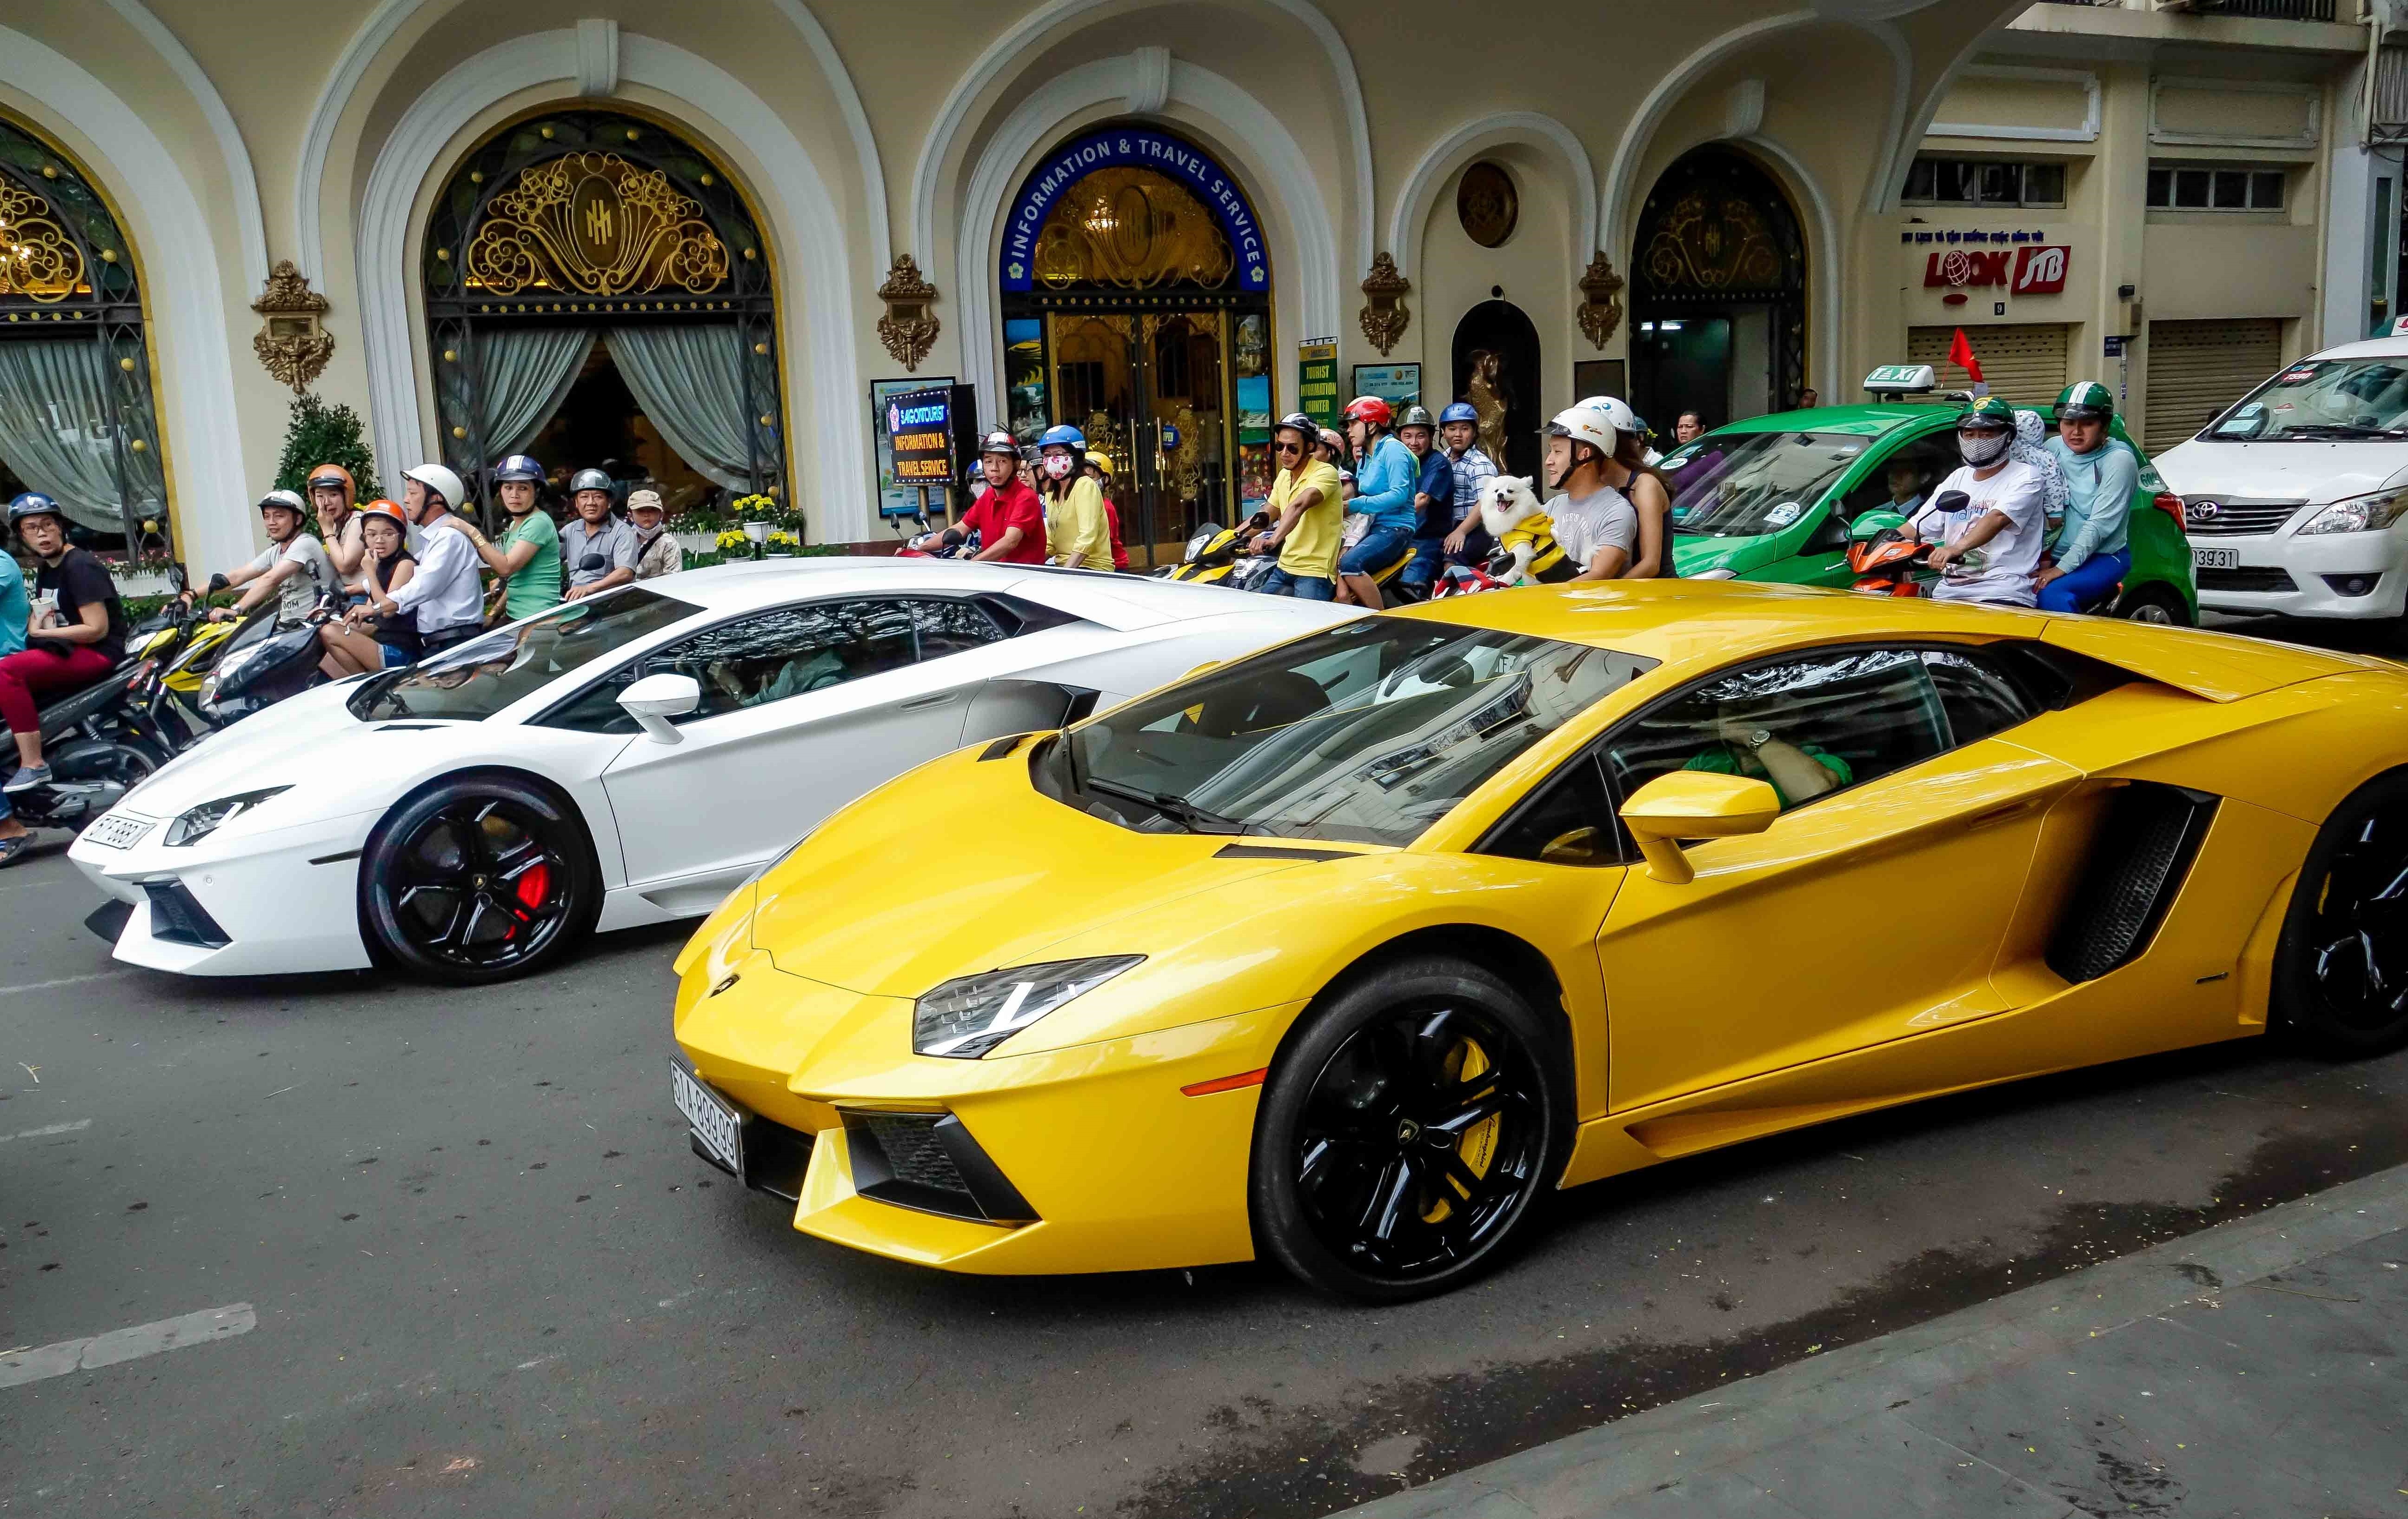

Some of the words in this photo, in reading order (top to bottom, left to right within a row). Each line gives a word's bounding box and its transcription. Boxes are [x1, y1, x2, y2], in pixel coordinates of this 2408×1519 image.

[1011, 141, 1110, 258] INFORMATION
[1119, 139, 1131, 154] &
[1138, 139, 1208, 181] TRAVEL
[1211, 179, 1260, 263] SERVICE
[2019, 248, 2064, 289] JTB
[1997, 304, 2002, 313] 9
[1306, 365, 1329, 379] TOURIST
[1301, 382, 1337, 397] INFORMATION
[1305, 400, 1329, 413] COUNTER
[895, 433, 938, 451] INFORMATION
[939, 432, 945, 448] &
[898, 461, 920, 476] TRAVEL
[920, 459, 947, 476] SERVICE
